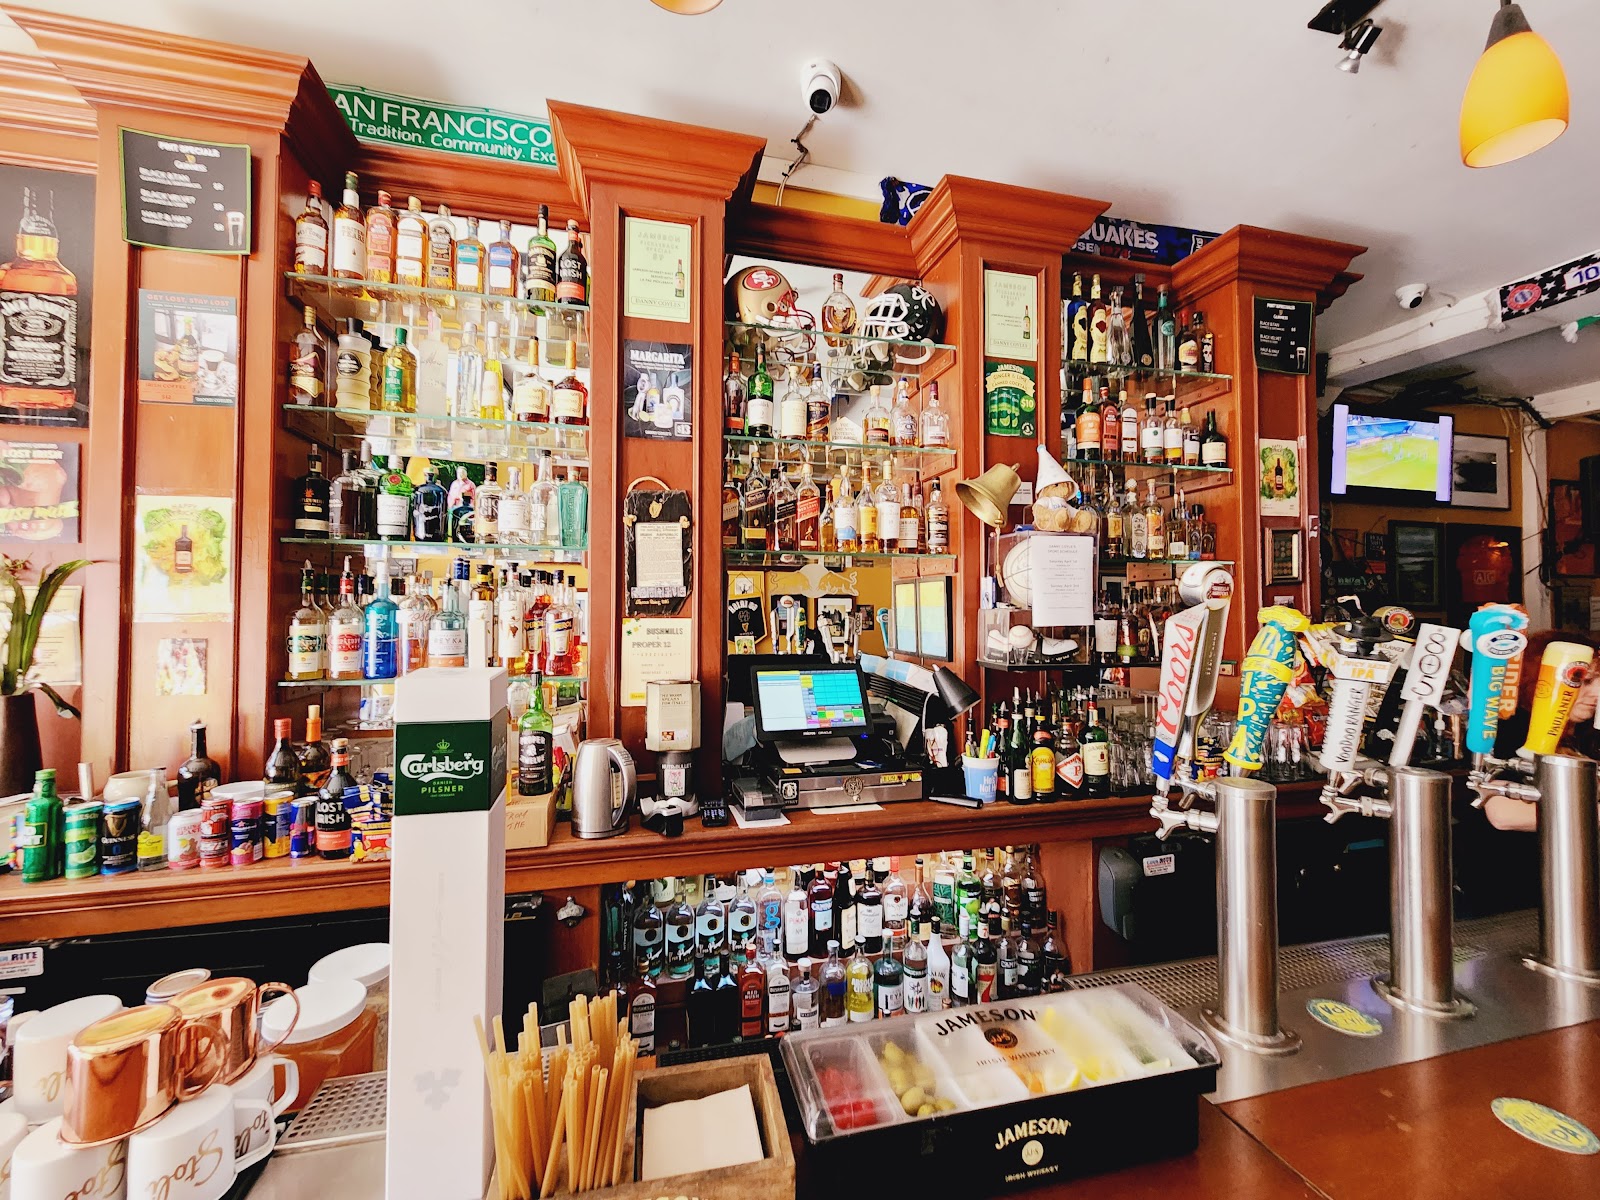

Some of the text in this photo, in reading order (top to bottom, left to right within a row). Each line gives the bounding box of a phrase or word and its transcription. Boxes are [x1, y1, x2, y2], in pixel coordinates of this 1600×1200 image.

[335, 93, 552, 147] AN FRANCISCO
[349, 118, 425, 144] Tradition.
[431, 131, 525, 160] Community.
[1572, 265, 1600, 283] 10
[190, 297, 209, 306] STAY
[210, 299, 230, 307] LOST
[630, 349, 685, 364] MARGARITA
[997, 363, 1025, 374] JAMESON
[993, 372, 1011, 380] GINGER
[1017, 375, 1028, 383] LIME
[1021, 398, 1034, 408] $10
[646, 627, 684, 635] BUSHMILLS
[632, 641, 662, 649] PROPER
[1156, 622, 1195, 735] Coors
[1351, 667, 1375, 679] IPA
[1489, 666, 1505, 692] BIG
[1482, 698, 1501, 740] WAVE
[1547, 690, 1574, 738] PAULANER
[1335, 686, 1366, 764] VOODOO RANGER
[400, 752, 484, 783] Carlsberg
[1074, 766, 1080, 776] P
[421, 785, 464, 793] PILSNER
[317, 801, 343, 812] LOST
[317, 813, 345, 825] IRISH
[101, 834, 135, 844] GUINNESS
[11, 951, 38, 961] RITE
[978, 974, 995, 1003] 7
[935, 1007, 1037, 1036] JAMESON
[976, 1048, 1056, 1067] IRISH WHISKEY
[994, 1117, 1071, 1149] JAMESON
[1004, 1164, 1059, 1182] IRISH WHISKEY
